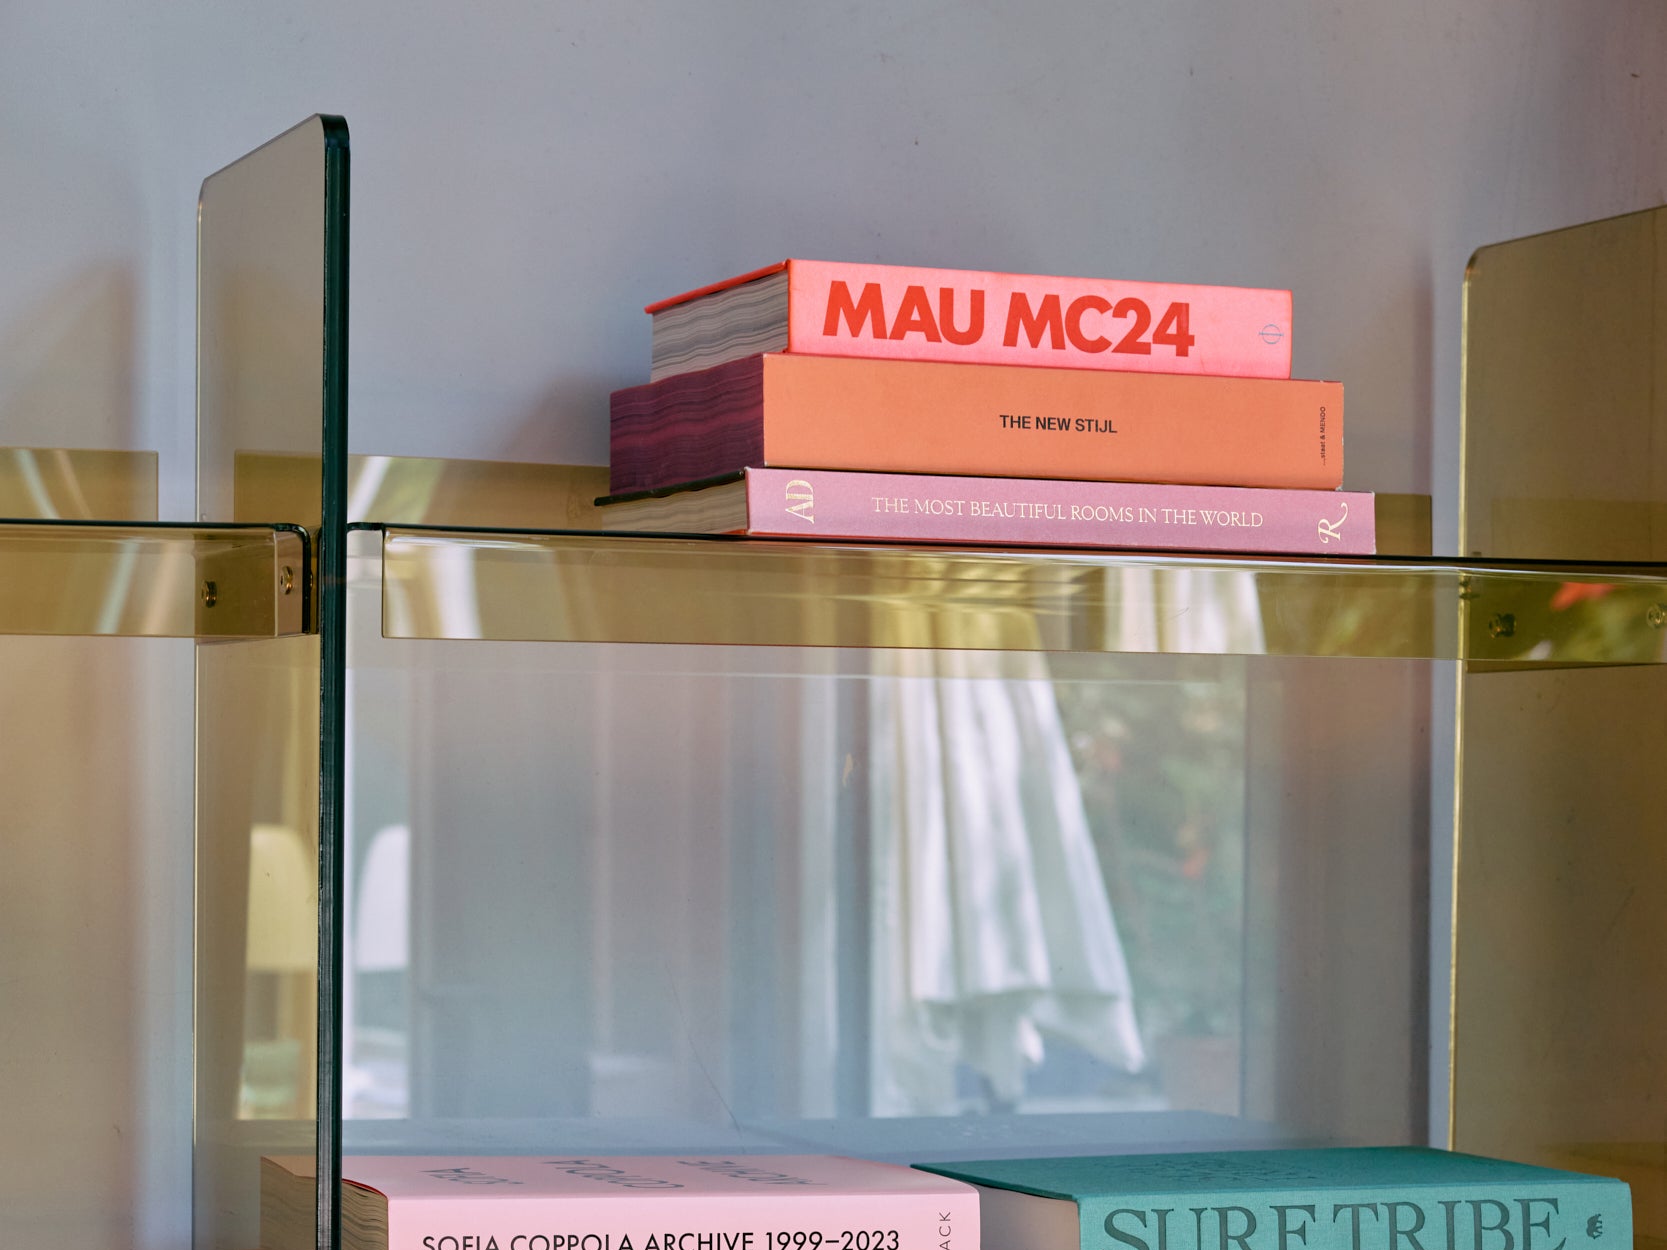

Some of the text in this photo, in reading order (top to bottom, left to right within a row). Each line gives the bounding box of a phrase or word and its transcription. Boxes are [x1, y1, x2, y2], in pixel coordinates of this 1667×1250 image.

[822, 280, 1195, 358] MAU MC24
[1000, 414, 1118, 434] THE NEW STIJL
[785, 479, 815, 525] AD
[871, 496, 1264, 528] THE MOST BEAUTIFUL ROOMS IN THE WORLD
[1317, 502, 1349, 544] R
